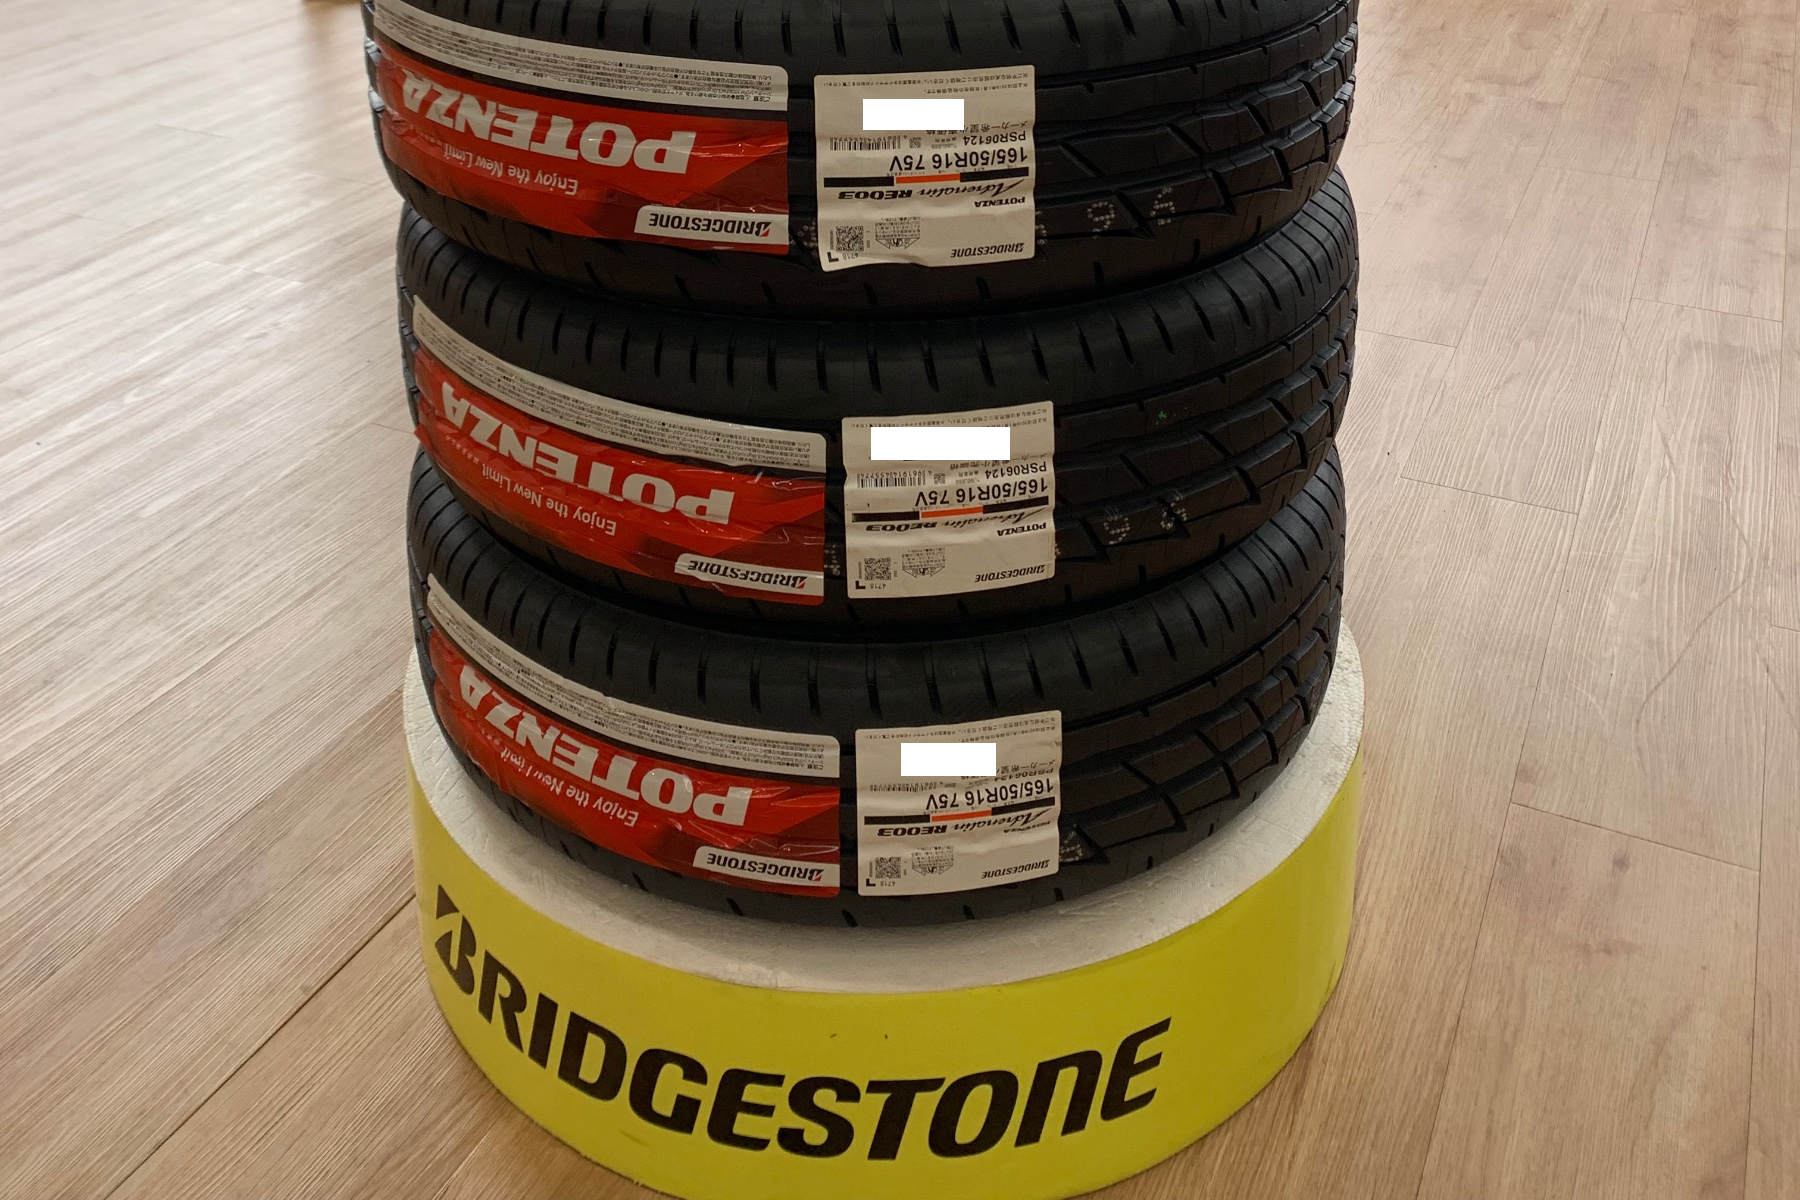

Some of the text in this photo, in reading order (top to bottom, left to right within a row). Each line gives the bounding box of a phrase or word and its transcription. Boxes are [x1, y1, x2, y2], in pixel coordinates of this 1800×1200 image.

[401, 67, 697, 174] POTENZA
[963, 131, 1027, 146] PSR06124
[443, 143, 578, 195] Enjoy the New Limit
[889, 147, 1028, 172] 165/50R16 75V
[838, 189, 913, 200] RE003
[974, 196, 1026, 208] POTENZA
[649, 213, 772, 238] BRIDGESTONE
[950, 243, 1025, 259] BRIDGESTONE
[440, 381, 736, 525] POTENZA
[985, 461, 1047, 480] PSR06124
[481, 464, 617, 536] Enjoy the New Limit
[914, 478, 1049, 507] 165/50R16 75V
[865, 522, 938, 532] RE003
[997, 522, 1047, 537] POTENZA
[686, 559, 807, 589] BRIDGESTONE
[974, 564, 1046, 583] BRIDGESTONE
[458, 665, 753, 826] POTENZA
[532, 770, 563, 796] New
[964, 778, 1055, 805] 165/50R16
[565, 785, 591, 810] the
[925, 793, 959, 810] 75V
[592, 795, 640, 828] Enjoy
[877, 824, 948, 836] RE003
[706, 852, 824, 882] BRIDGESTONE
[981, 859, 1050, 879] BRIDGESTONE
[435, 884, 1172, 1161] BRIDGESTONE
